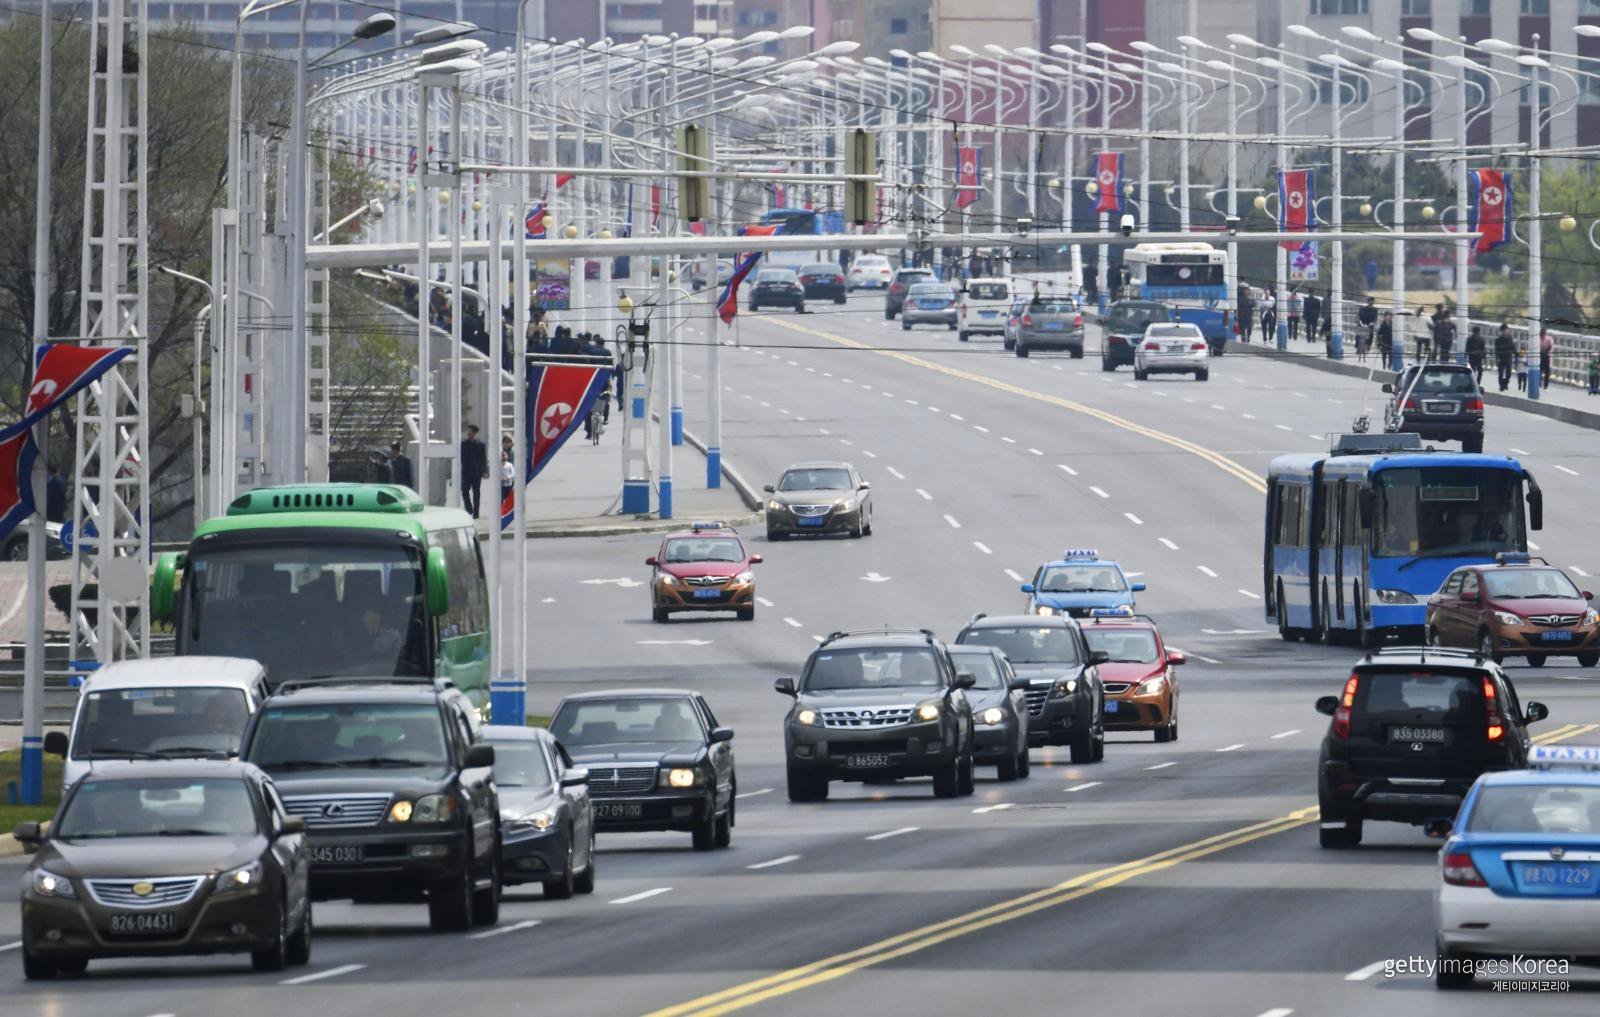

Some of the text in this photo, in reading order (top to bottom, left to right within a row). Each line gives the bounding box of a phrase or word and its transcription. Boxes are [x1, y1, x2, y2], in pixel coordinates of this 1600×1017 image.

[1393, 728, 1412, 739] 835
[856, 755, 888, 766] 865052
[1560, 866, 1590, 883] 1229
[112, 914, 174, 930] 826 04431
